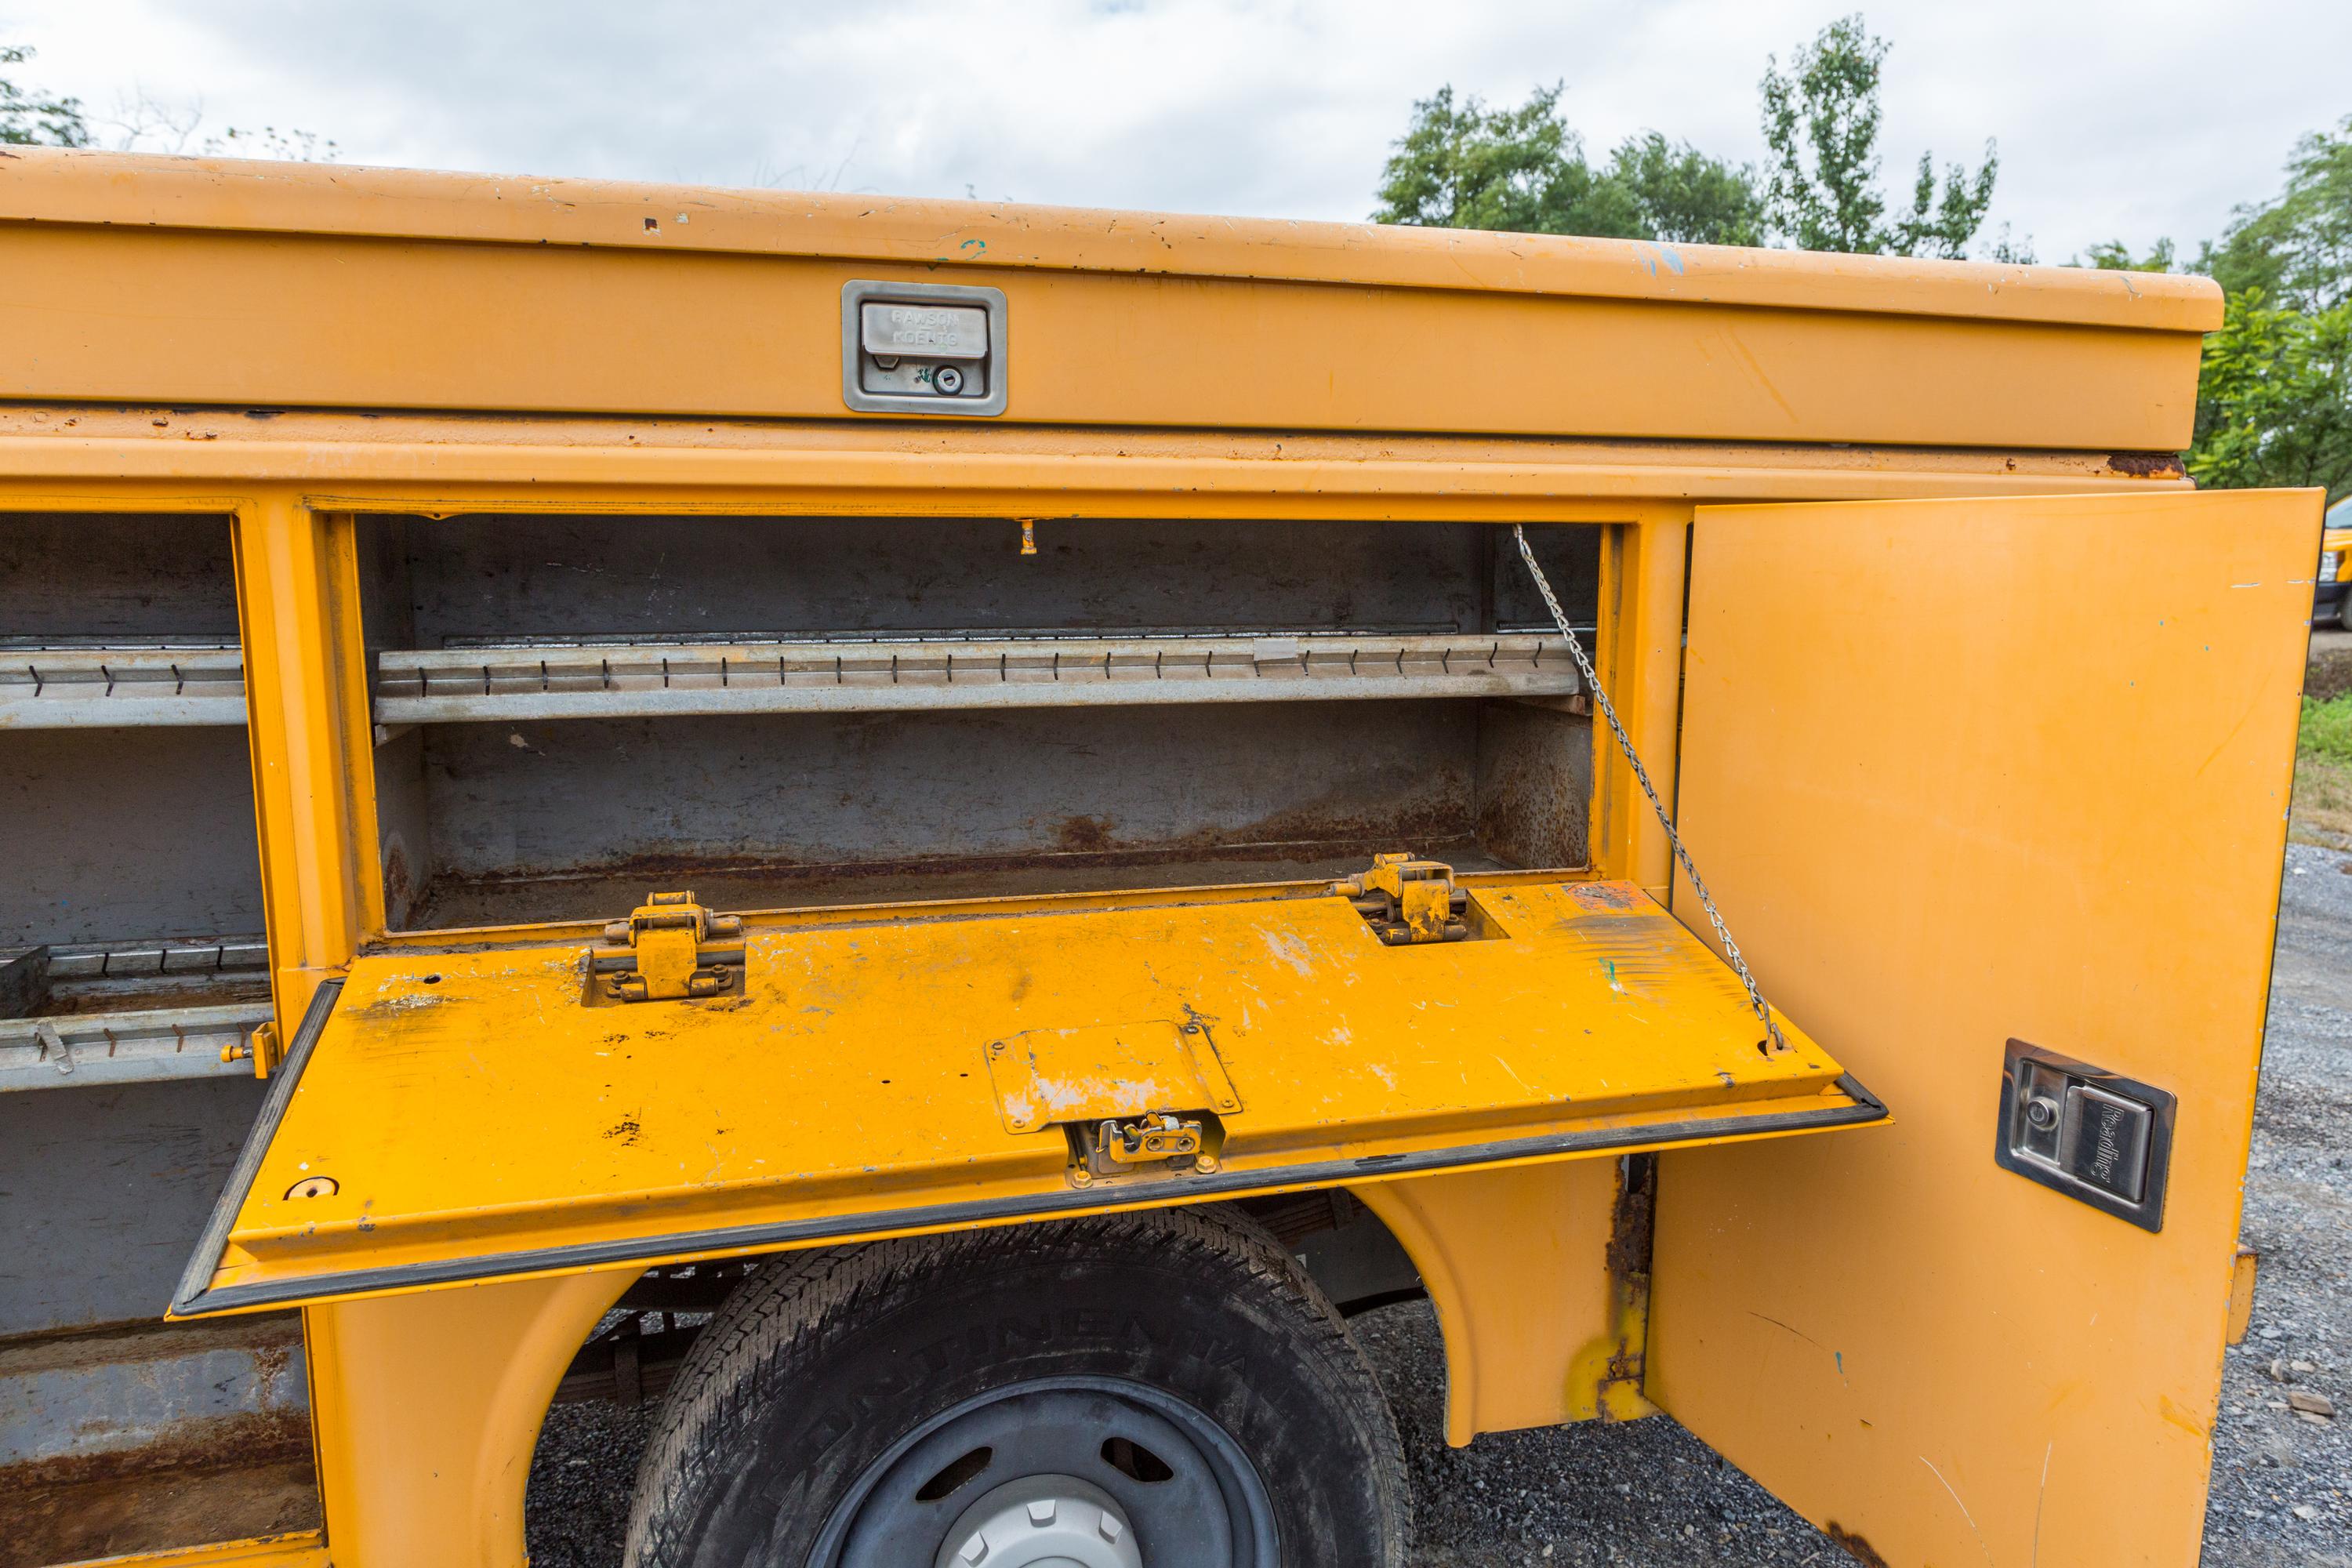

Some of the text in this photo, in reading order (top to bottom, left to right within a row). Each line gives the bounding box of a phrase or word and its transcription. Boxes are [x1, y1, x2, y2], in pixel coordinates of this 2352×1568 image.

[891, 310, 960, 327] RAWSON
[893, 330, 957, 347] KOENIG
[2089, 1103, 2125, 1181] Reading
